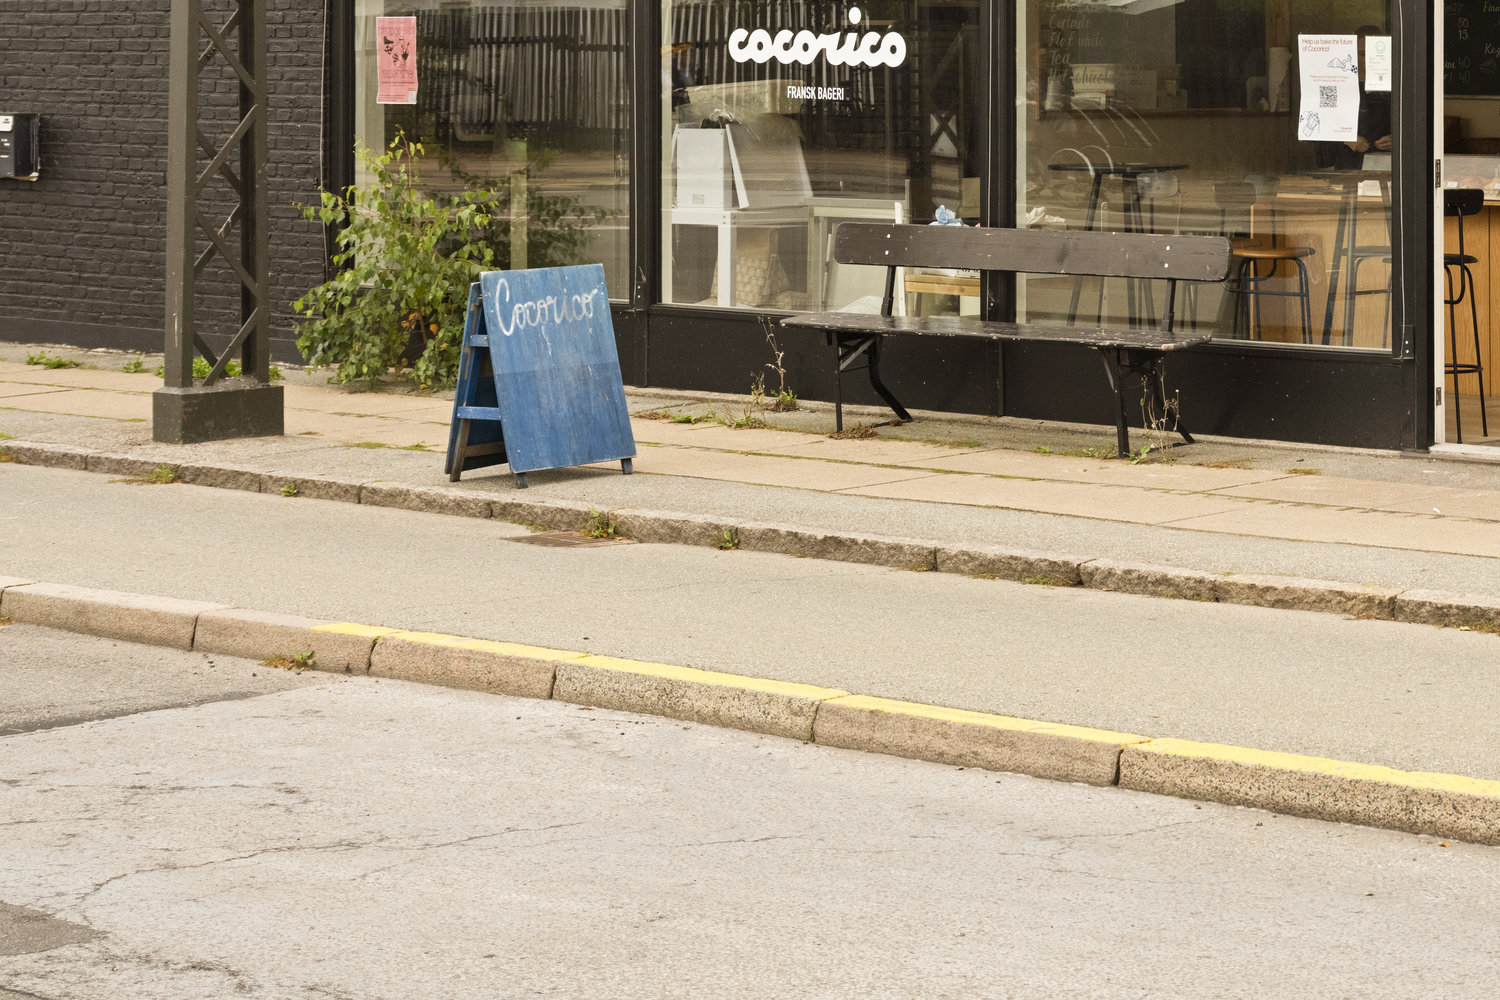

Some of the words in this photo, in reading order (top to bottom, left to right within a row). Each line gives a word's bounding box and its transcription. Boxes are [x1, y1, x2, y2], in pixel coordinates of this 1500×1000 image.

[728, 6, 907, 68] cocorico
[786, 85, 816, 100] FRANSK
[817, 86, 845, 101] BAGERI
[495, 277, 599, 337] Cocorico
